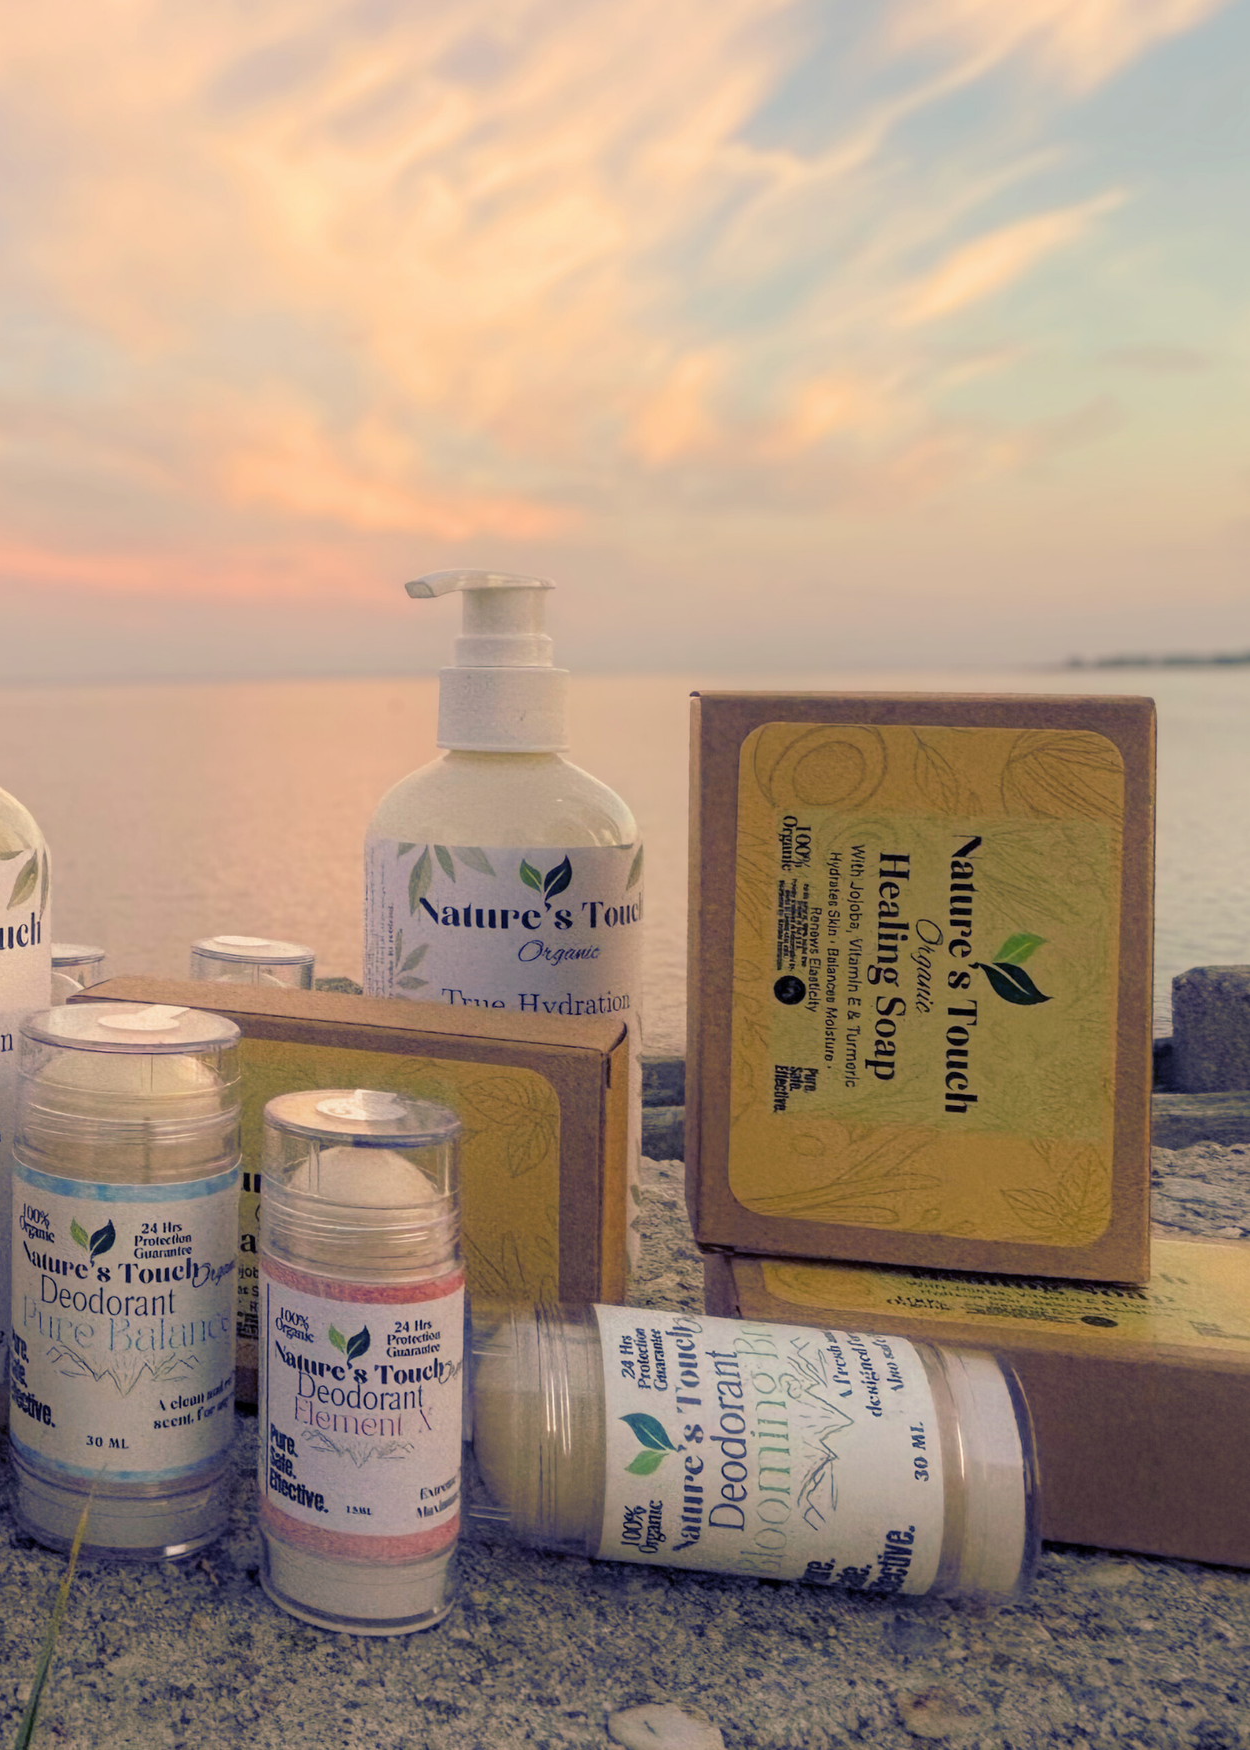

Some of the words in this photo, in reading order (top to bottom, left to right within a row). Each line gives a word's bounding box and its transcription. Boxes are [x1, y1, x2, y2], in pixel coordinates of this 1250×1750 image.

[780, 814, 798, 872] Organic
[794, 825, 812, 869] 100%
[850, 844, 866, 878] With
[825, 851, 843, 908] Hydrates
[419, 896, 573, 931] Nature's
[827, 909, 841, 936] Skin
[849, 880, 866, 934] Jojoba,
[867, 852, 910, 988] Healing
[948, 834, 982, 990] Nature's
[517, 939, 600, 967] Organic
[809, 907, 823, 956] Renews
[805, 958, 822, 1013] Elasticity
[826, 948, 840, 1002] Balances
[847, 938, 863, 993] Vitamin
[910, 918, 944, 1015] Organic
[848, 997, 861, 1007] E
[848, 1010, 860, 1020] &
[824, 1006, 838, 1063] Moisture
[864, 995, 906, 1082] Soap
[845, 1025, 862, 1088] Turmeric
[945, 999, 978, 1114] Touch
[23, 1203, 50, 1231] 100%
[141, 1223, 158, 1235] 24
[163, 1221, 182, 1234] Hrs
[133, 1245, 192, 1260] Guarantee
[134, 1233, 192, 1247] Protection
[23, 1241, 111, 1283] Nature's
[118, 1258, 199, 1284] Touch
[41, 1274, 175, 1317] Deodorant
[23, 1295, 94, 1342] Pure
[275, 1316, 314, 1344] Organic
[280, 1306, 309, 1332] 100%
[387, 1330, 441, 1346] Protection
[394, 1320, 410, 1334] 24
[414, 1319, 432, 1331] Hrs
[275, 1340, 368, 1384] Nature's
[374, 1358, 444, 1385] Touch
[386, 1343, 441, 1359] Guarantee
[619, 1335, 634, 1355] Hrs
[633, 1327, 652, 1391] Protection
[650, 1328, 669, 1392] Guarantee
[297, 1371, 423, 1411] Deodorant
[665, 1326, 701, 1414] Touch
[294, 1395, 403, 1437] Element
[86, 1435, 103, 1447] 30
[109, 1437, 129, 1449] ML
[270, 1423, 299, 1459] Pure.
[705, 1350, 748, 1532] Deodorant
[671, 1423, 705, 1552] Nature's
[913, 1456, 930, 1482] 30
[620, 1505, 646, 1547] 100%
[638, 1499, 666, 1555] Organic
